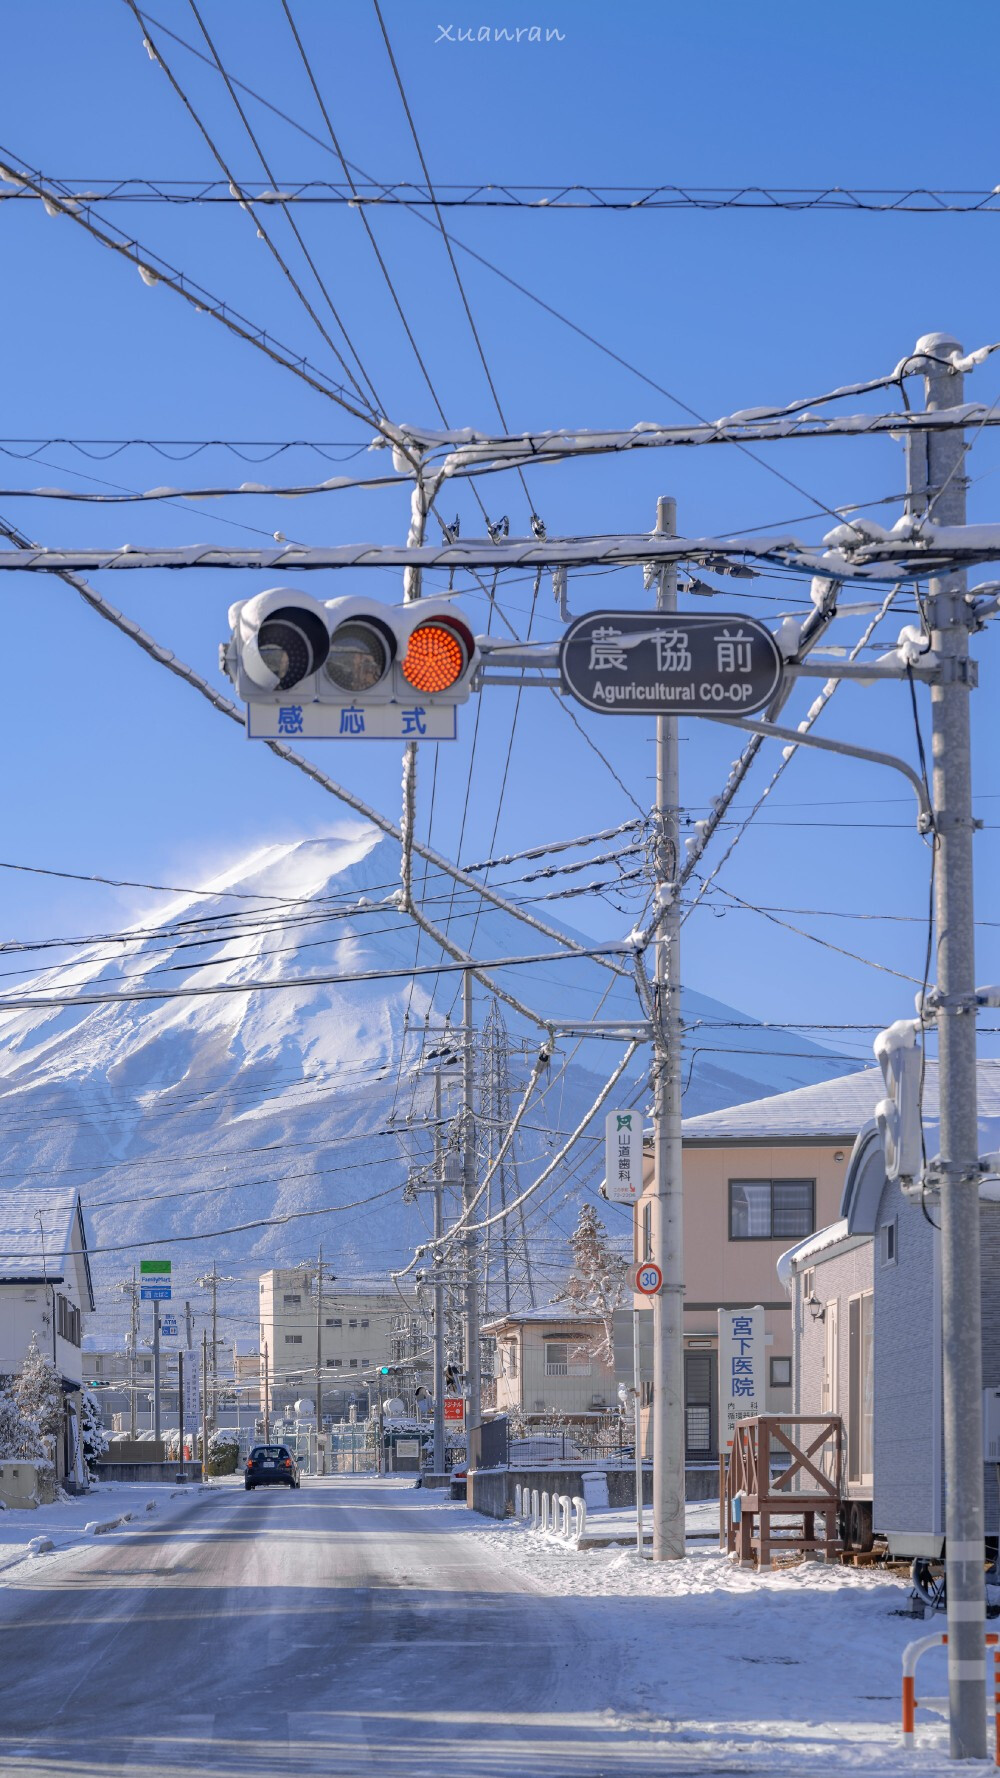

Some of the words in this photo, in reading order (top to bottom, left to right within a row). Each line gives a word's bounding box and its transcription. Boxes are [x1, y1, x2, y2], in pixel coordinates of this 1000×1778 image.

[588, 626, 753, 674] 農協前
[592, 680, 696, 702] Aguricultural
[699, 684, 753, 702] CO-OP
[277, 705, 428, 734] 感応式
[618, 1134, 631, 1182] 山道歯科
[642, 1271, 657, 1287] 30
[731, 1316, 755, 1397] 宮下医院
